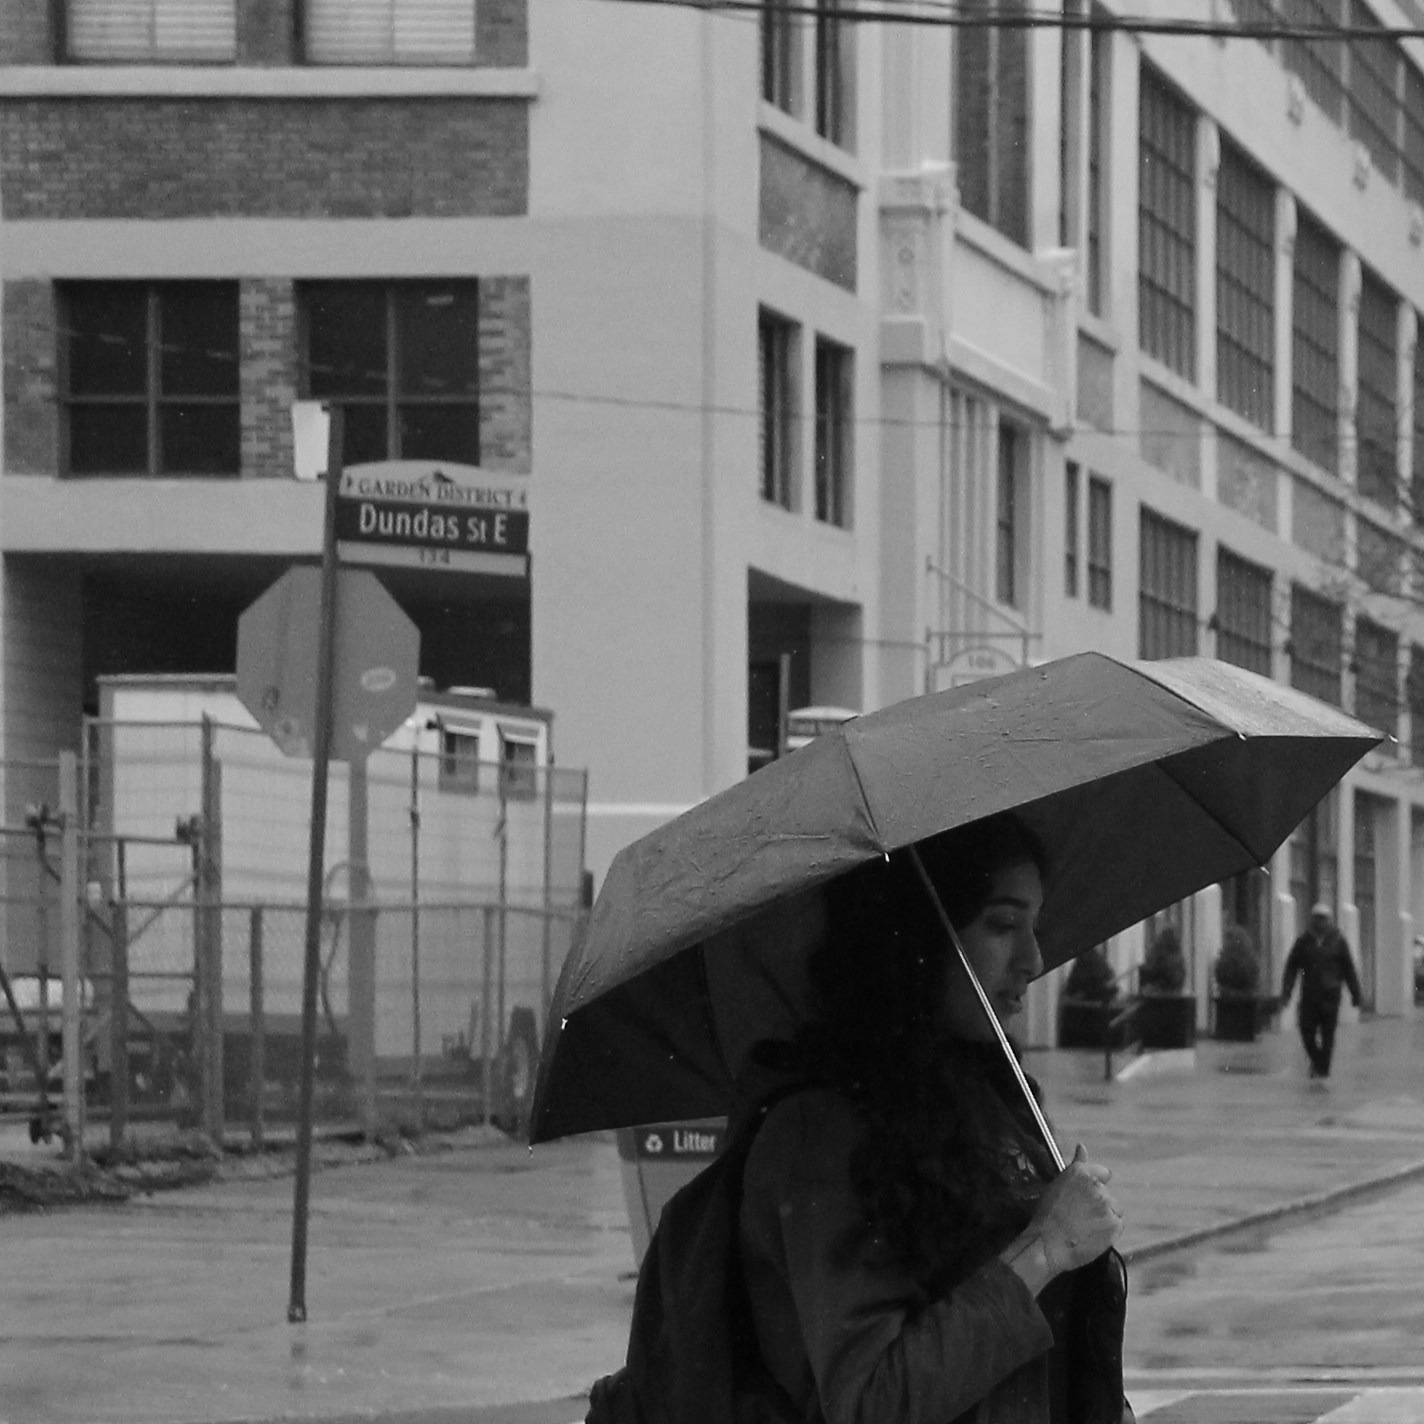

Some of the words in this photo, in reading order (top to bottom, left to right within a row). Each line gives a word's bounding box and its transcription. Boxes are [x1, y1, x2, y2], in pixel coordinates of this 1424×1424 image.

[358, 477, 432, 498] GARDEN
[435, 481, 514, 505] DISTRICT
[359, 502, 460, 541] Dundas
[466, 515, 487, 544] St
[494, 512, 509, 545] E
[673, 1129, 716, 1153] Litter
